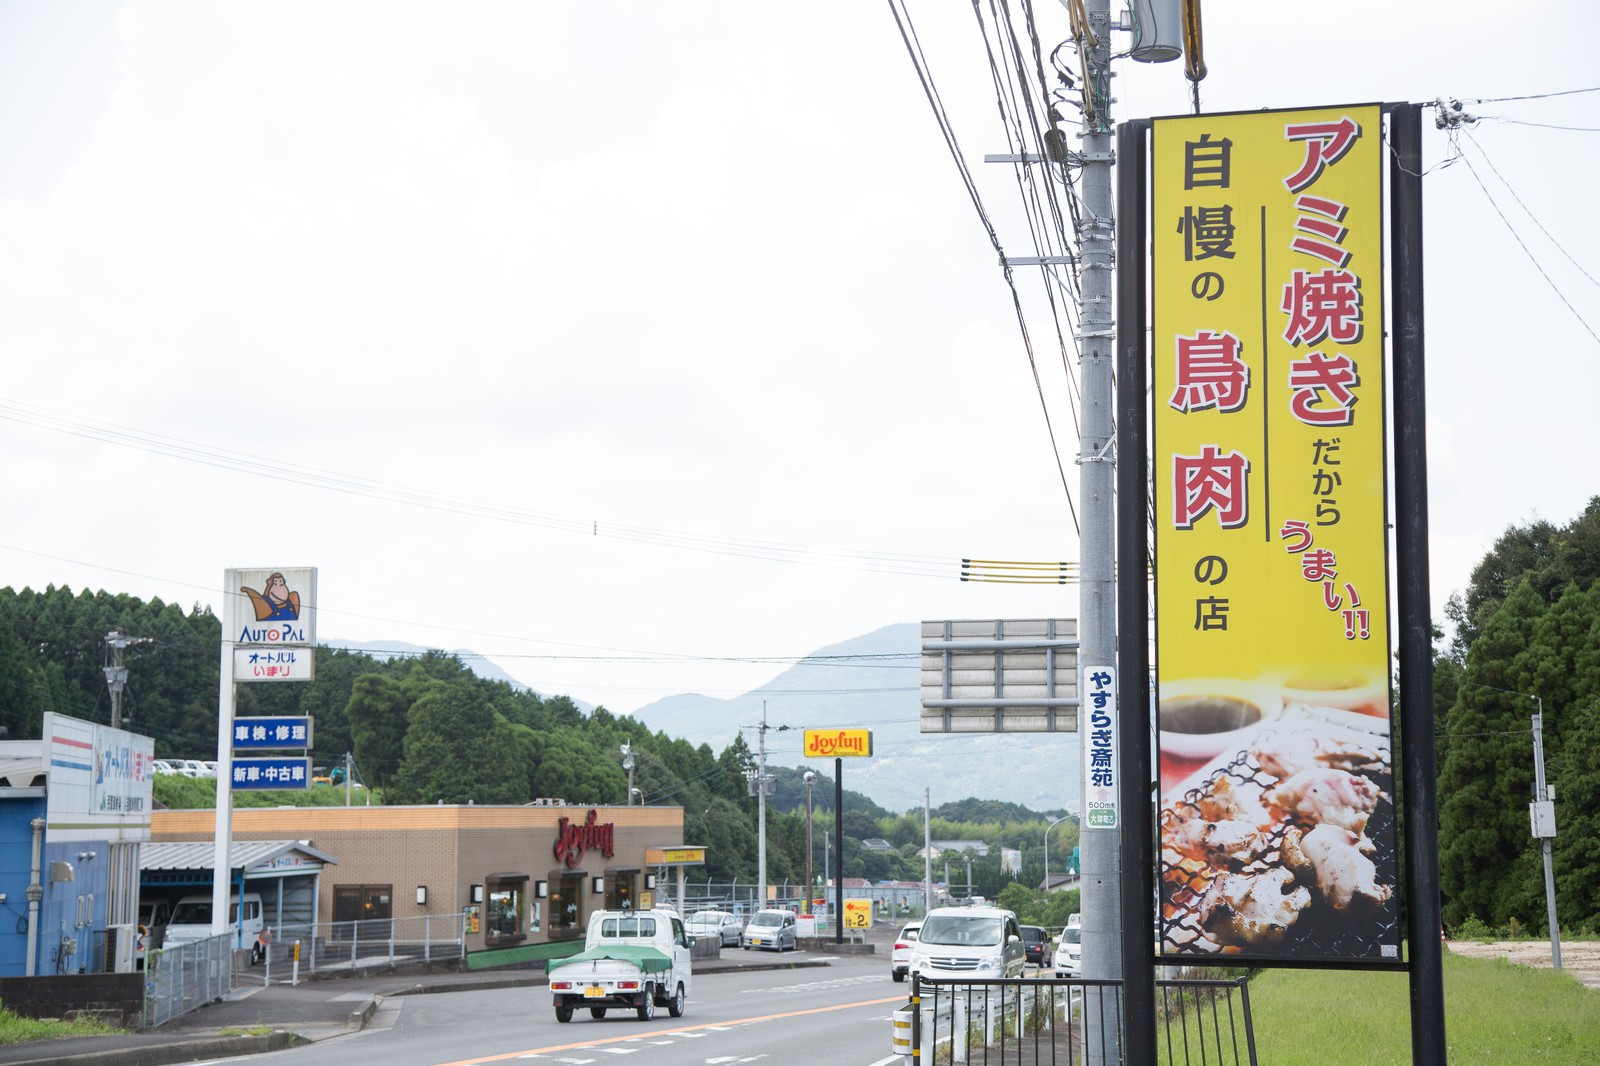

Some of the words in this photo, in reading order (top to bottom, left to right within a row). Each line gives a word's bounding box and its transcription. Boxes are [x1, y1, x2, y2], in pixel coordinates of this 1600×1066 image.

[249, 652, 296, 664] オートパル
[254, 665, 291, 677] いまり
[235, 725, 306, 741] 車検・修理
[809, 731, 863, 754] Joyfull
[233, 766, 305, 782] 新車・中古車
[554, 809, 614, 868] Joyfull
